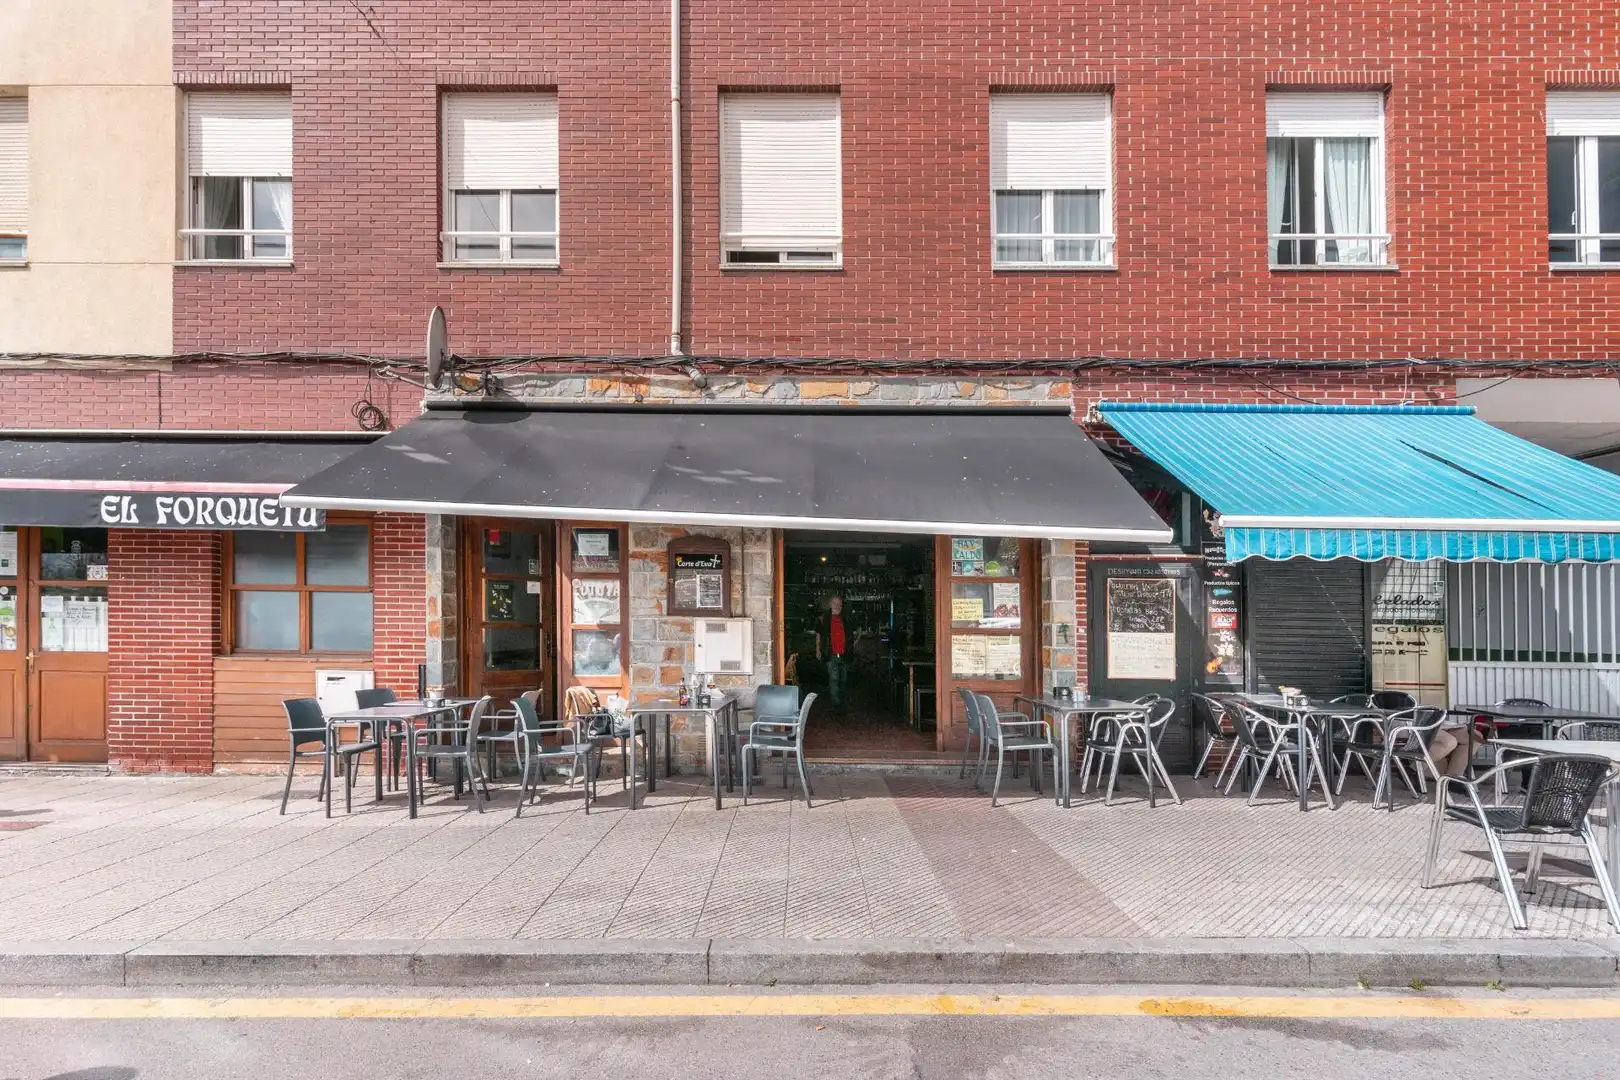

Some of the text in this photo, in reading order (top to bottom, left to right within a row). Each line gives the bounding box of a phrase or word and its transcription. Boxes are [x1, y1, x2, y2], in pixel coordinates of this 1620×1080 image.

[100, 495, 139, 524] EL
[953, 550, 982, 560] CALDO
[1373, 626, 1444, 634] egalos
